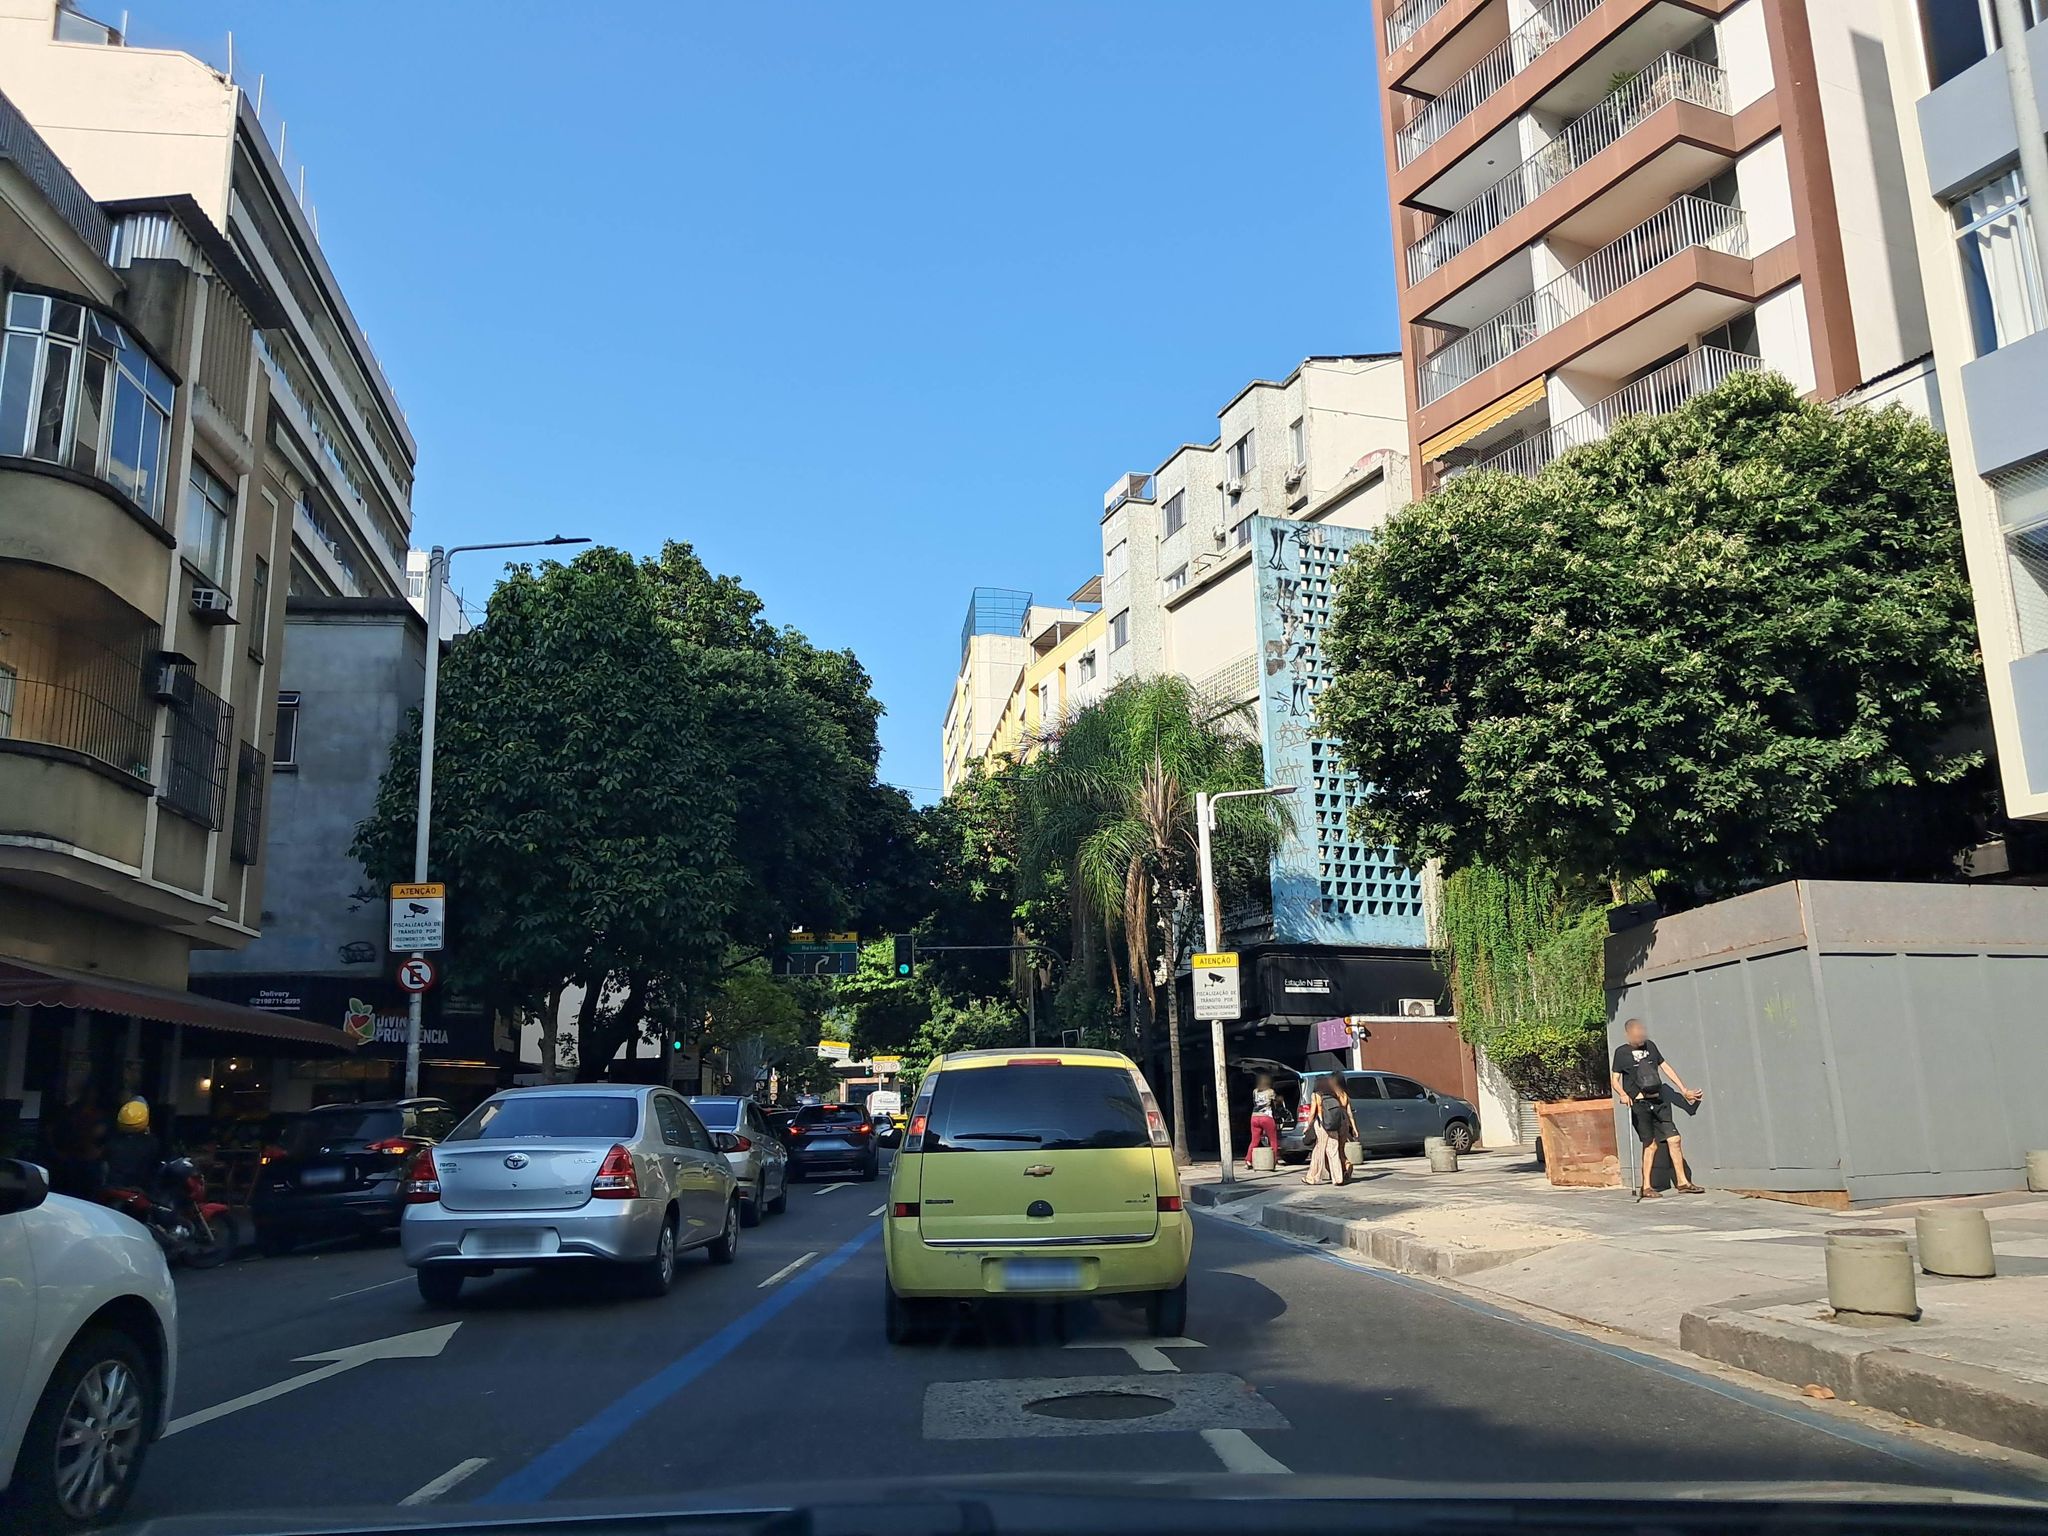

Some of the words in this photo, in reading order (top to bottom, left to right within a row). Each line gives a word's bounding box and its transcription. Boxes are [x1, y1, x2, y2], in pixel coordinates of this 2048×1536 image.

[400, 886, 436, 895] ATENÇÃO
[1199, 956, 1231, 965] ATENÇÃO
[409, 965, 422, 985] E
[1307, 979, 1330, 987] NET
[260, 990, 290, 998] Delivery
[376, 1016, 409, 1028] DIVIN
